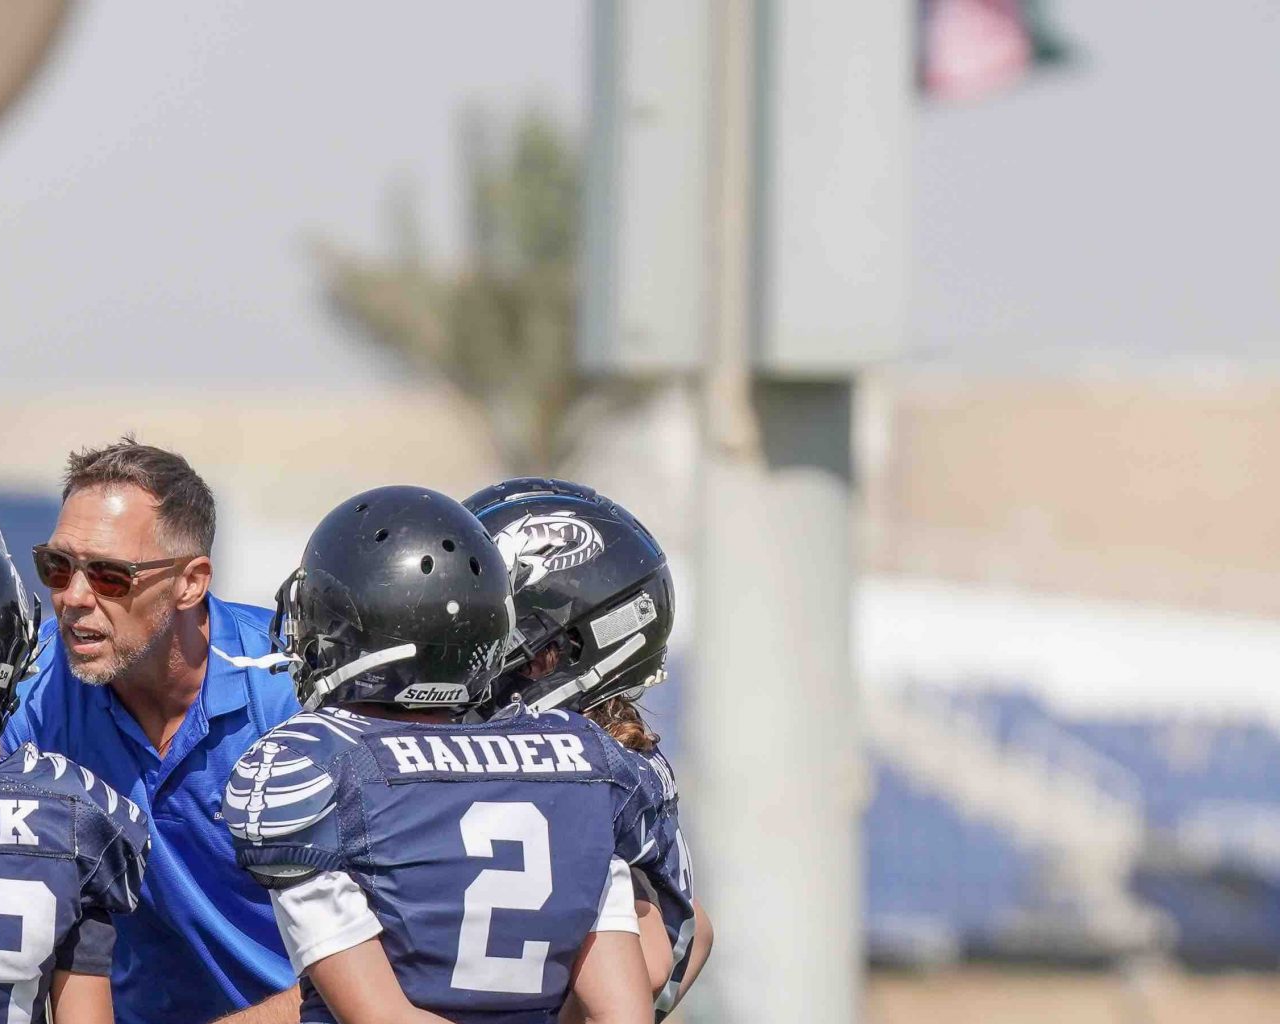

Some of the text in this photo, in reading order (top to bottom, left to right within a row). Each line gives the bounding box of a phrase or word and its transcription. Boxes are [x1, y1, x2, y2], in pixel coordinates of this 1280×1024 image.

[404, 687, 463, 702] schutt
[380, 734, 593, 774] HAIDER
[450, 801, 554, 994] 2
